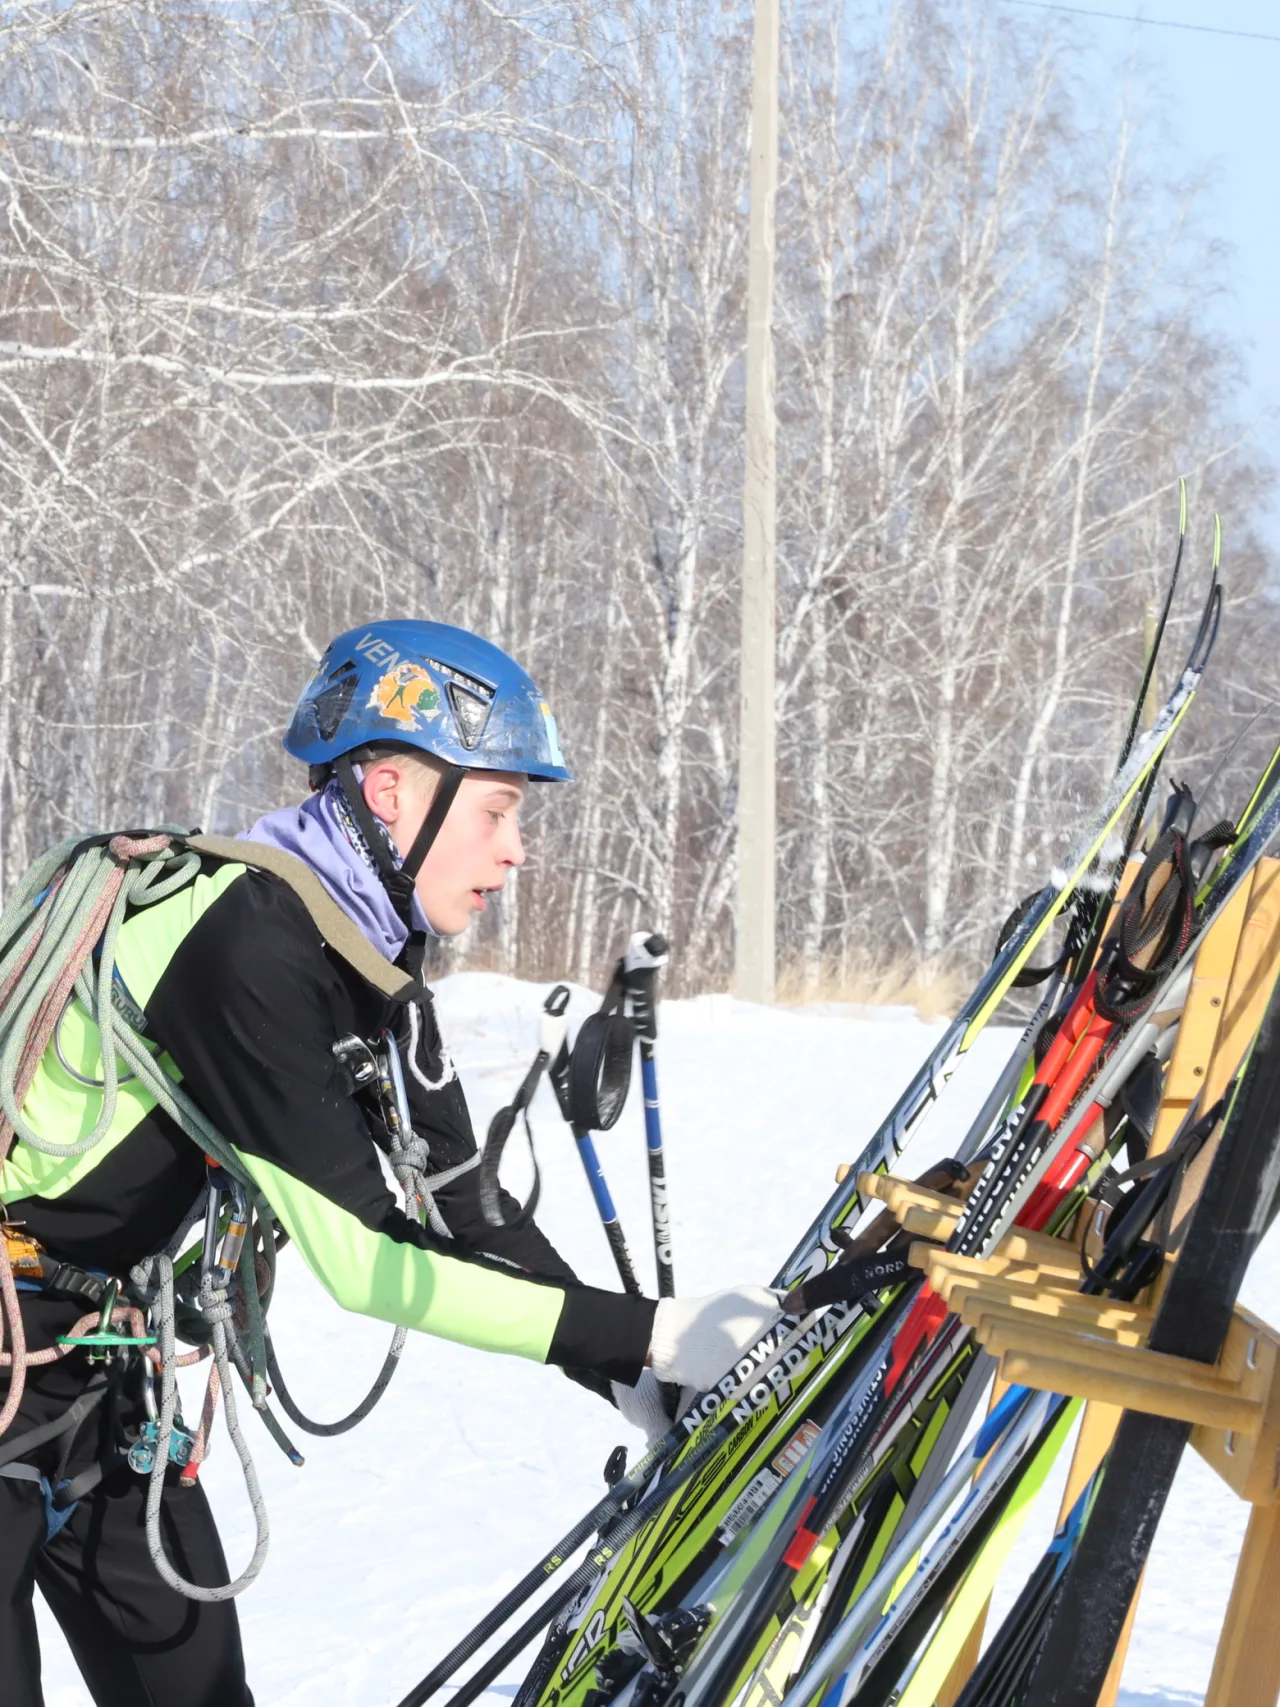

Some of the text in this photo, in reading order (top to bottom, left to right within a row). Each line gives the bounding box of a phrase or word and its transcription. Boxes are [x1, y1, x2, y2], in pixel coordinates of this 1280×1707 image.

[354, 631, 411, 674] VEN
[681, 1313, 804, 1437] NORDWAY
[731, 1299, 853, 1426] NORDWAY
[727, 1416, 754, 1456] CARBON
[543, 1554, 564, 1575] RS
[593, 1546, 614, 1568] RS
